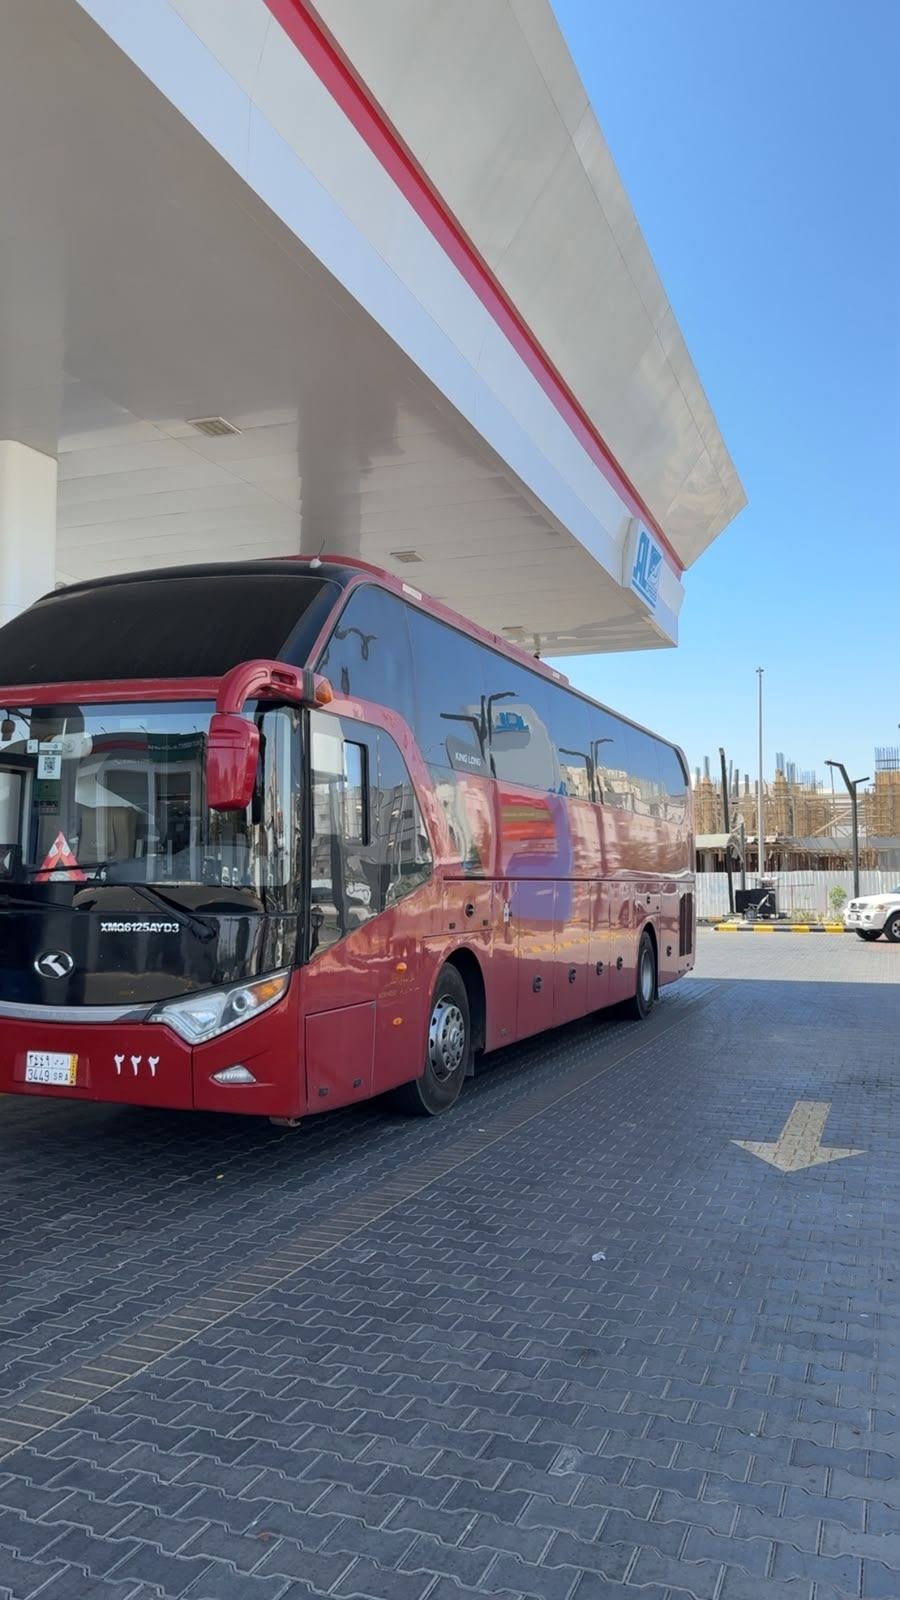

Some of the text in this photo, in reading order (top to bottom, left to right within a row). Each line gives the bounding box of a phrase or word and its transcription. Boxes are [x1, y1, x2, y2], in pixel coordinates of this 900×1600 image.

[456, 752, 480, 766] KING LONG
[100, 922, 180, 933] XMQ6125AYD3
[28, 1068, 49, 1082] 3449
